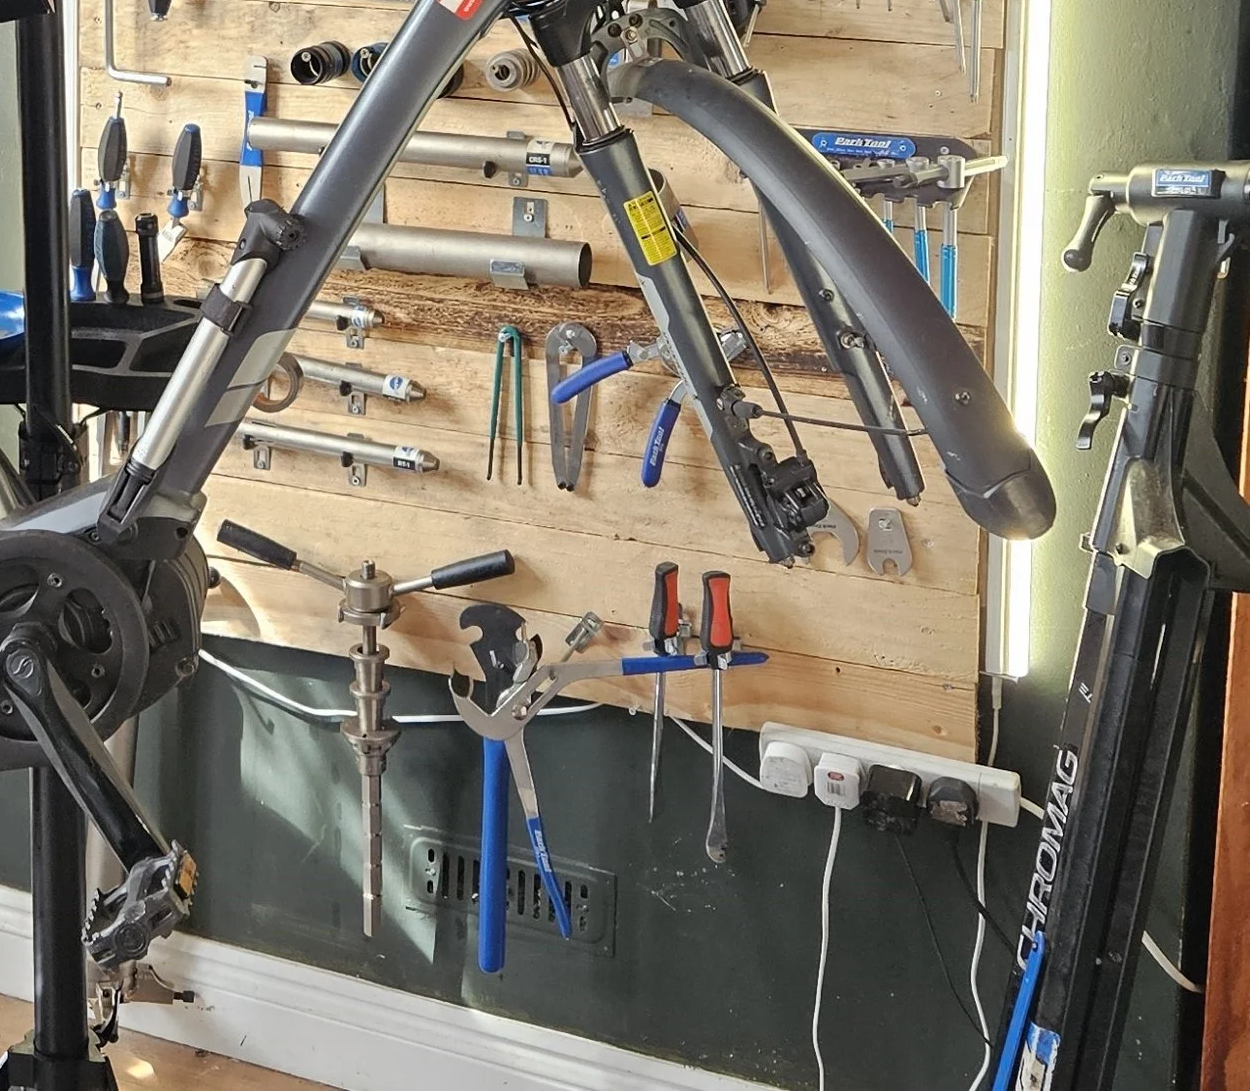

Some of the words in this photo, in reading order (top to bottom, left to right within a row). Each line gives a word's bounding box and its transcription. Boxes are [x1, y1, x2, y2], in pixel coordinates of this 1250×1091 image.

[835, 137, 864, 146] Park
[864, 139, 891, 148] Tool
[1160, 174, 1183, 182] Park
[1183, 175, 1206, 183] Tool
[1016, 748, 1079, 971] CHROMAG
